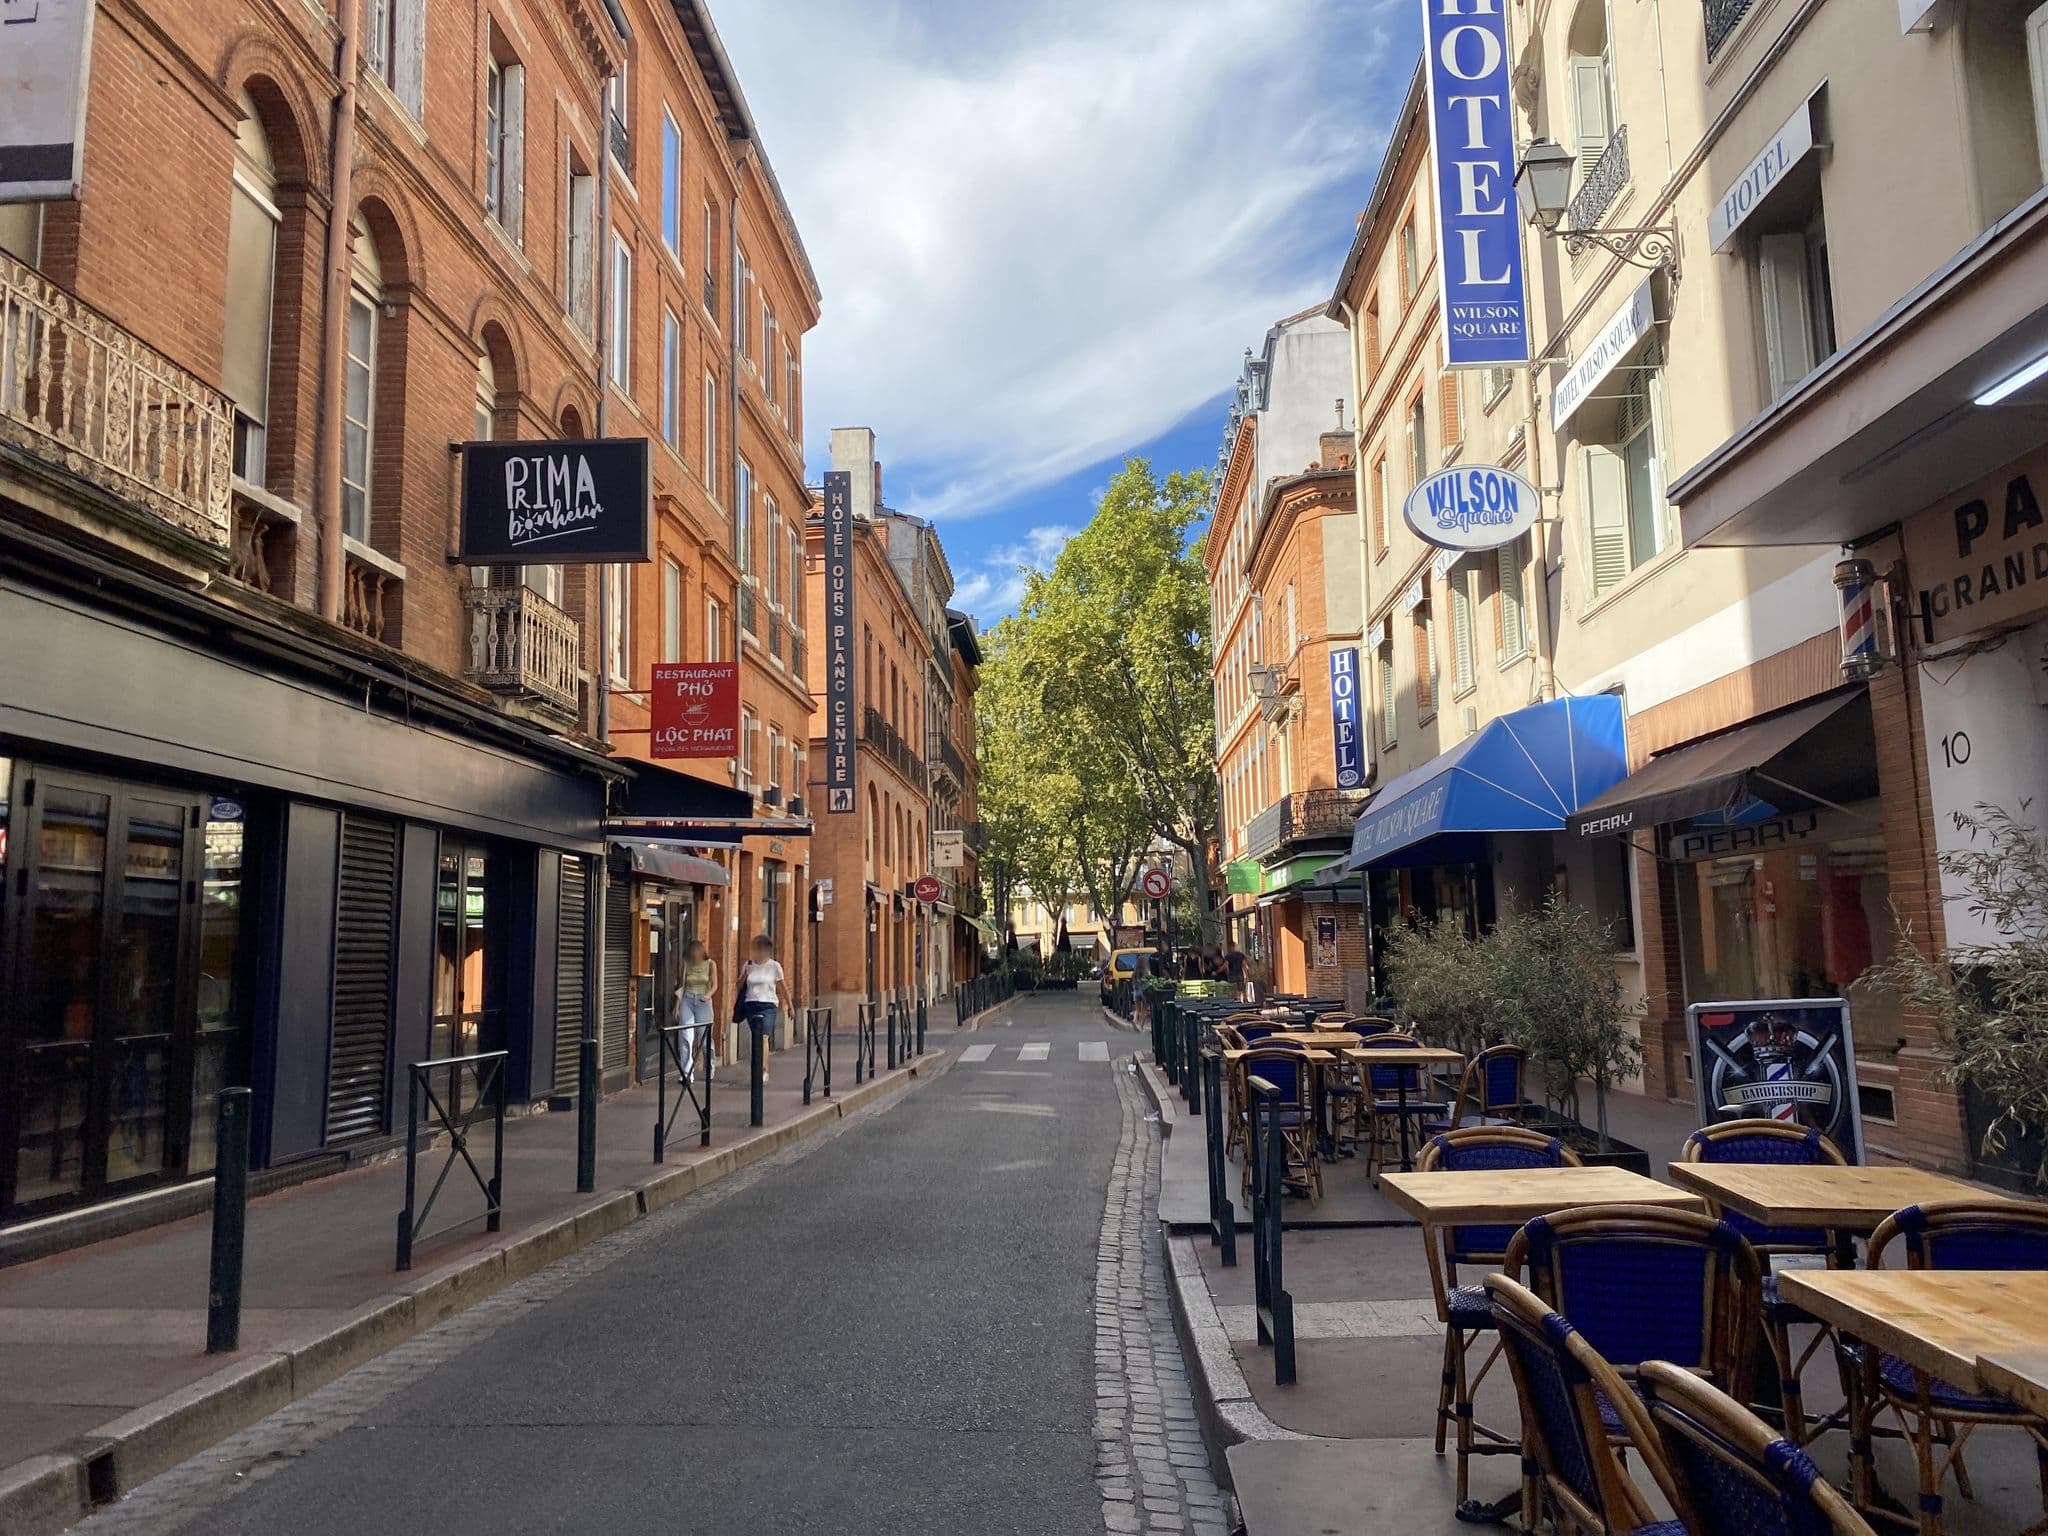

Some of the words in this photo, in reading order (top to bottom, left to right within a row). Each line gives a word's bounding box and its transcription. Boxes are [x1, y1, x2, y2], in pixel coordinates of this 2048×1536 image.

[1438, 0, 1511, 285] OTEL
[1724, 137, 1790, 230] HOTEL
[1453, 306, 1520, 319] WILSON
[1453, 322, 1521, 337] SQUARE
[1557, 375, 1580, 416] HOTEL
[1579, 340, 1610, 389] WILSON
[1609, 300, 1642, 356] SQUARE
[505, 454, 597, 510] PRIMA
[1426, 470, 1518, 517] WILSON
[832, 492, 844, 558] HÔTEL
[1437, 506, 1514, 533] Square
[832, 565, 844, 617] OURS
[656, 668, 734, 680] RESTAURANT
[834, 625, 846, 692] BLANC
[1332, 650, 1355, 768] HOTEL
[835, 701, 846, 782] CENTRE
[1940, 731, 1971, 768] 10
[1580, 812, 1633, 836] PERRY
[1684, 813, 1818, 858] PERRY
[1741, 1085, 1817, 1101] BARBERSHOP
